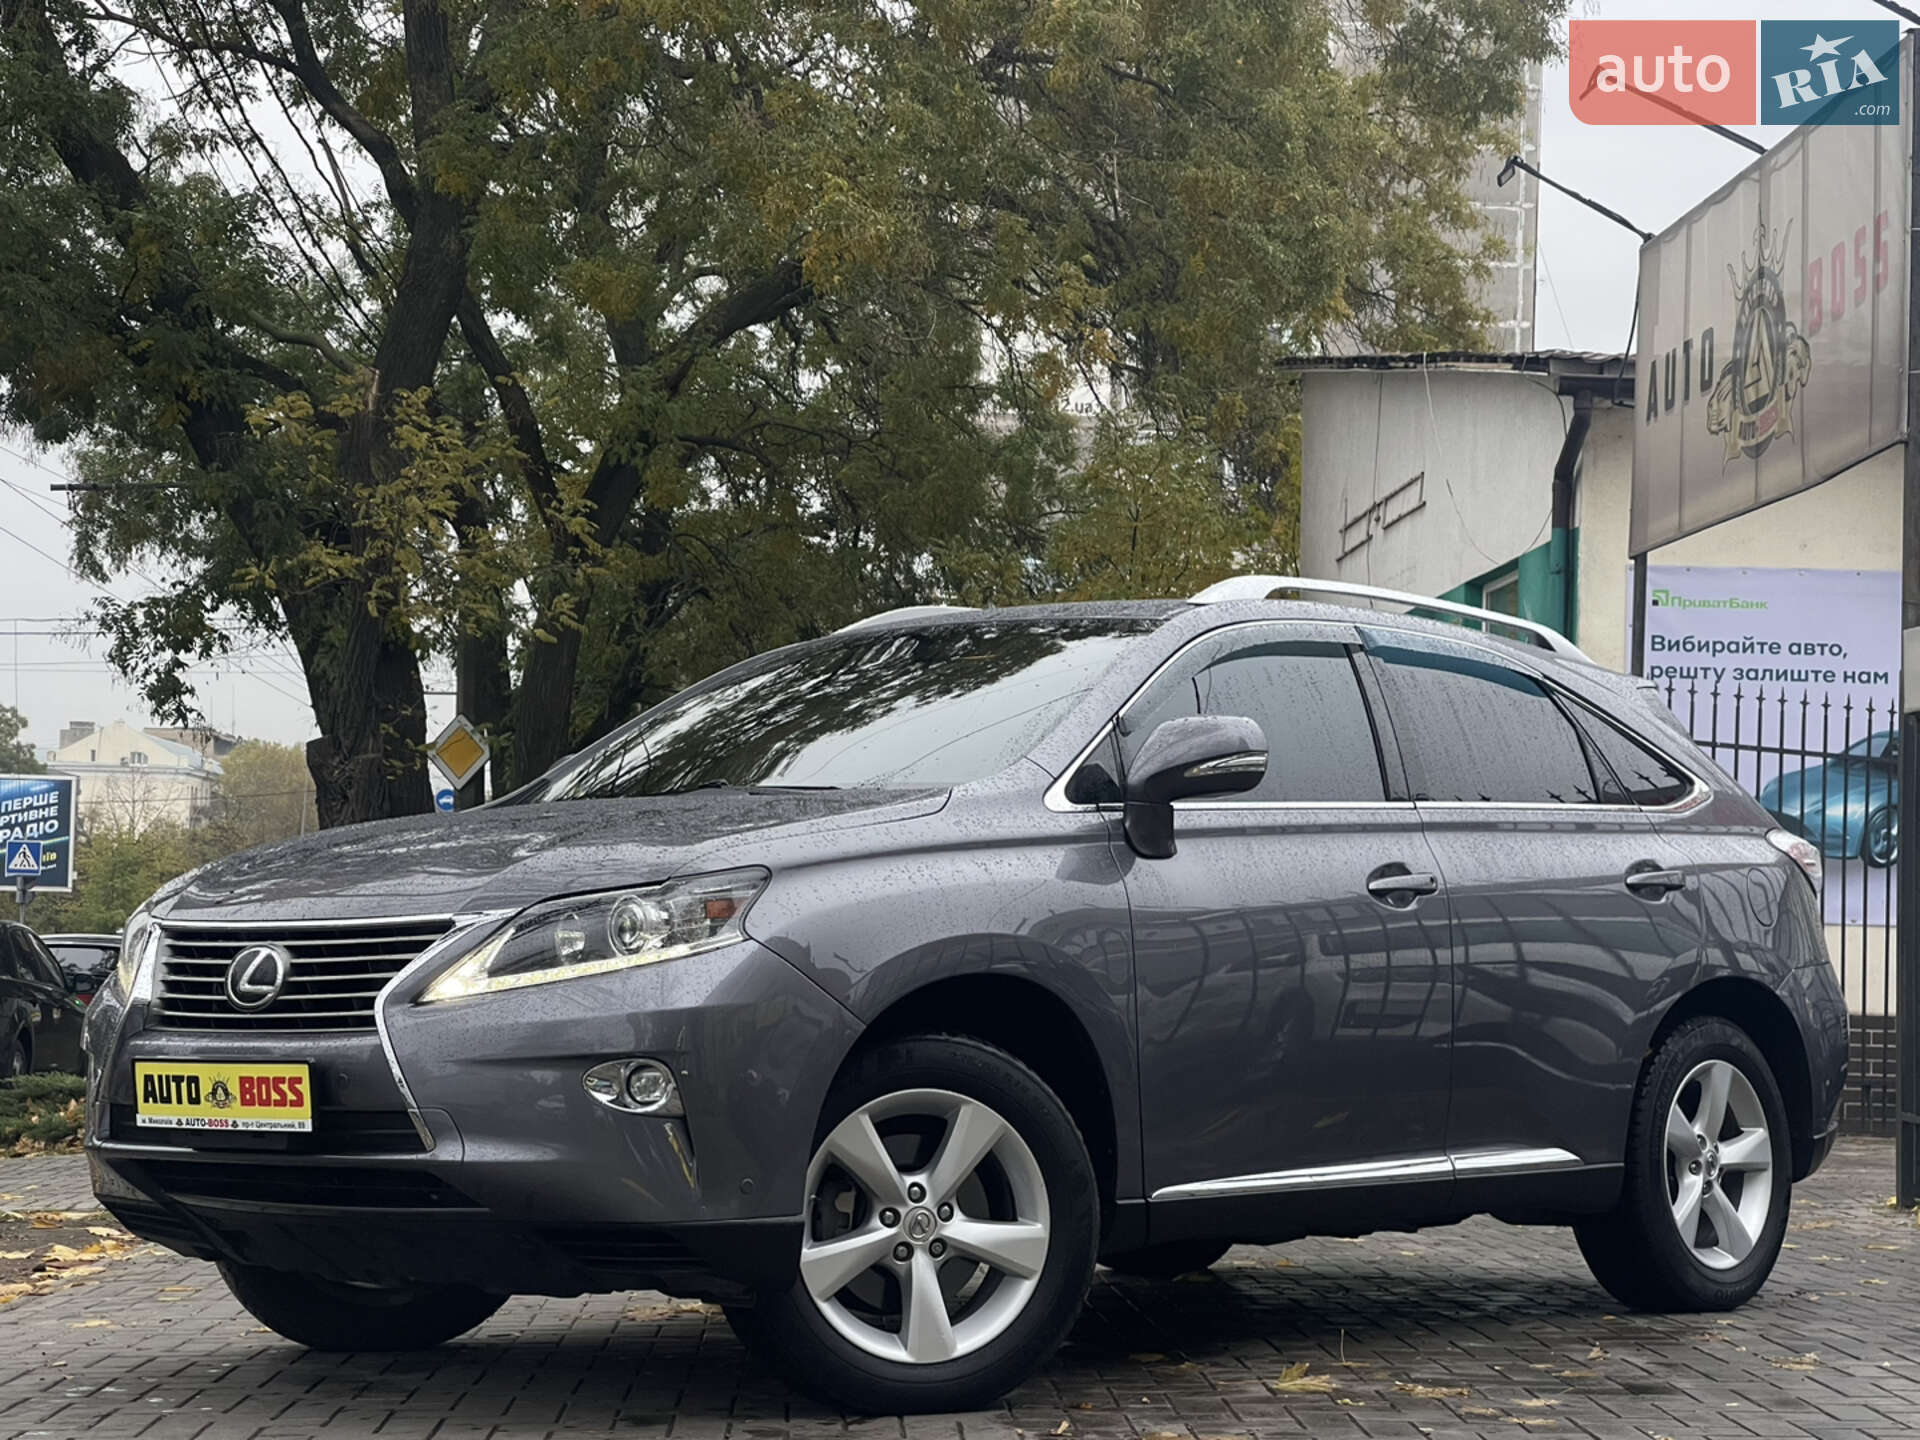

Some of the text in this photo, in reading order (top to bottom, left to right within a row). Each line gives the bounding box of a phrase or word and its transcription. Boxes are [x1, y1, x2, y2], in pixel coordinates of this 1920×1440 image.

[1646, 209, 1889, 425] AUTO BOSS
[1669, 596, 1769, 610] ПриватБанк
[1650, 634, 1848, 660] Вибирайте авто,
[1650, 664, 1889, 685] решту залиште нам
[1, 791, 59, 814] ПЕРШЕ
[0, 819, 59, 844] РАДІО
[143, 1074, 305, 1108] AUTO BOSS
[185, 1117, 229, 1128] AUTO-BOSS
